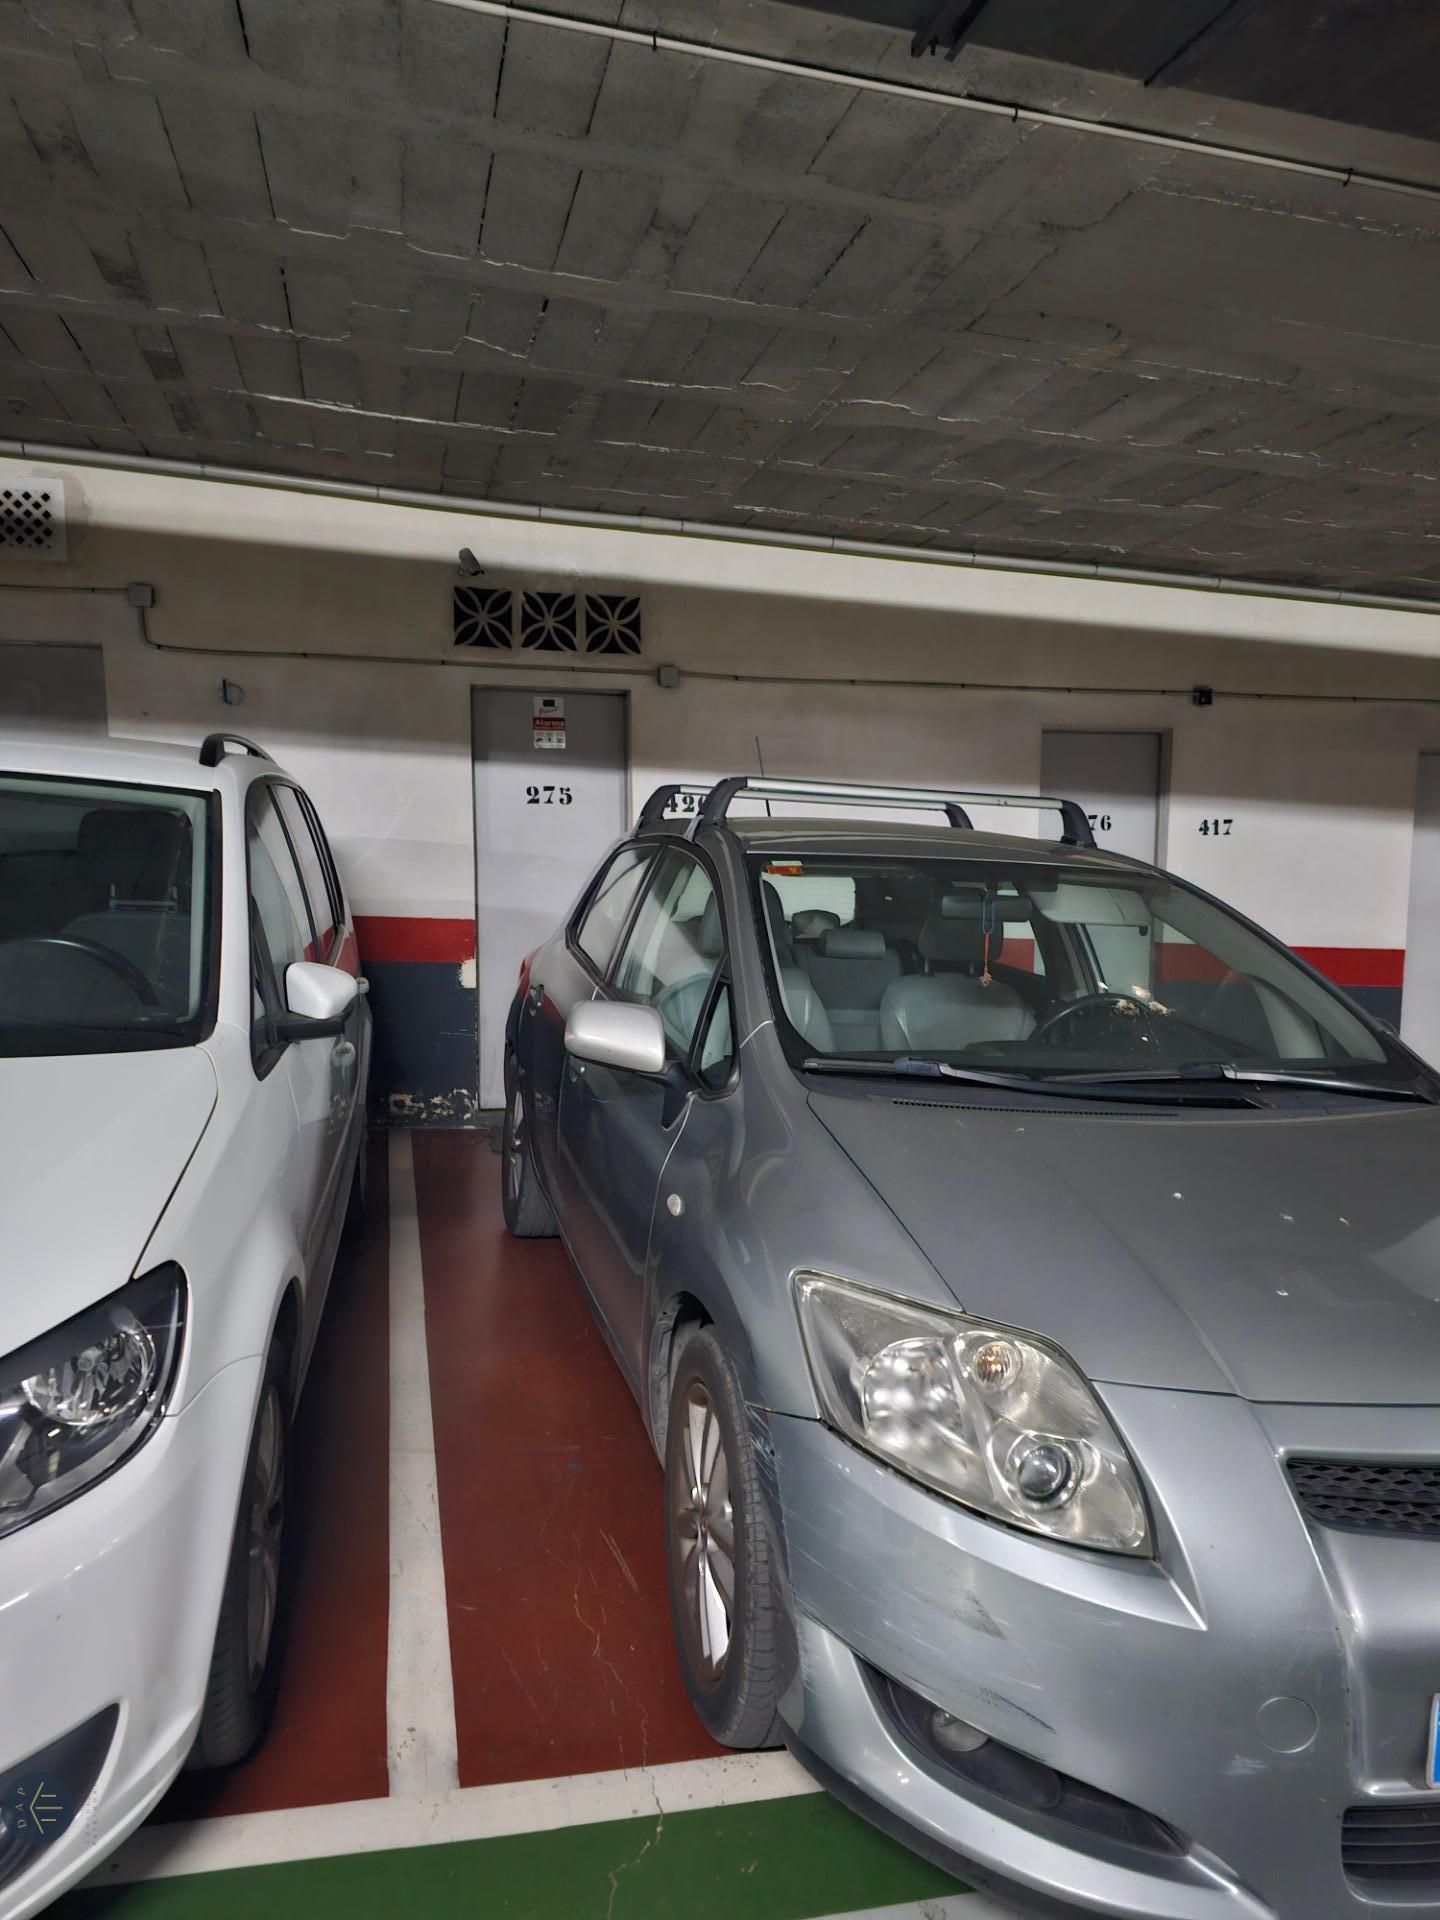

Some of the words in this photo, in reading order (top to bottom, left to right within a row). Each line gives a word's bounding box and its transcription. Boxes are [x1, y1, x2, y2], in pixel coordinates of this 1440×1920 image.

[526, 786, 572, 805] 275
[1088, 815, 1112, 831] 76
[1198, 819, 1233, 836] 417
